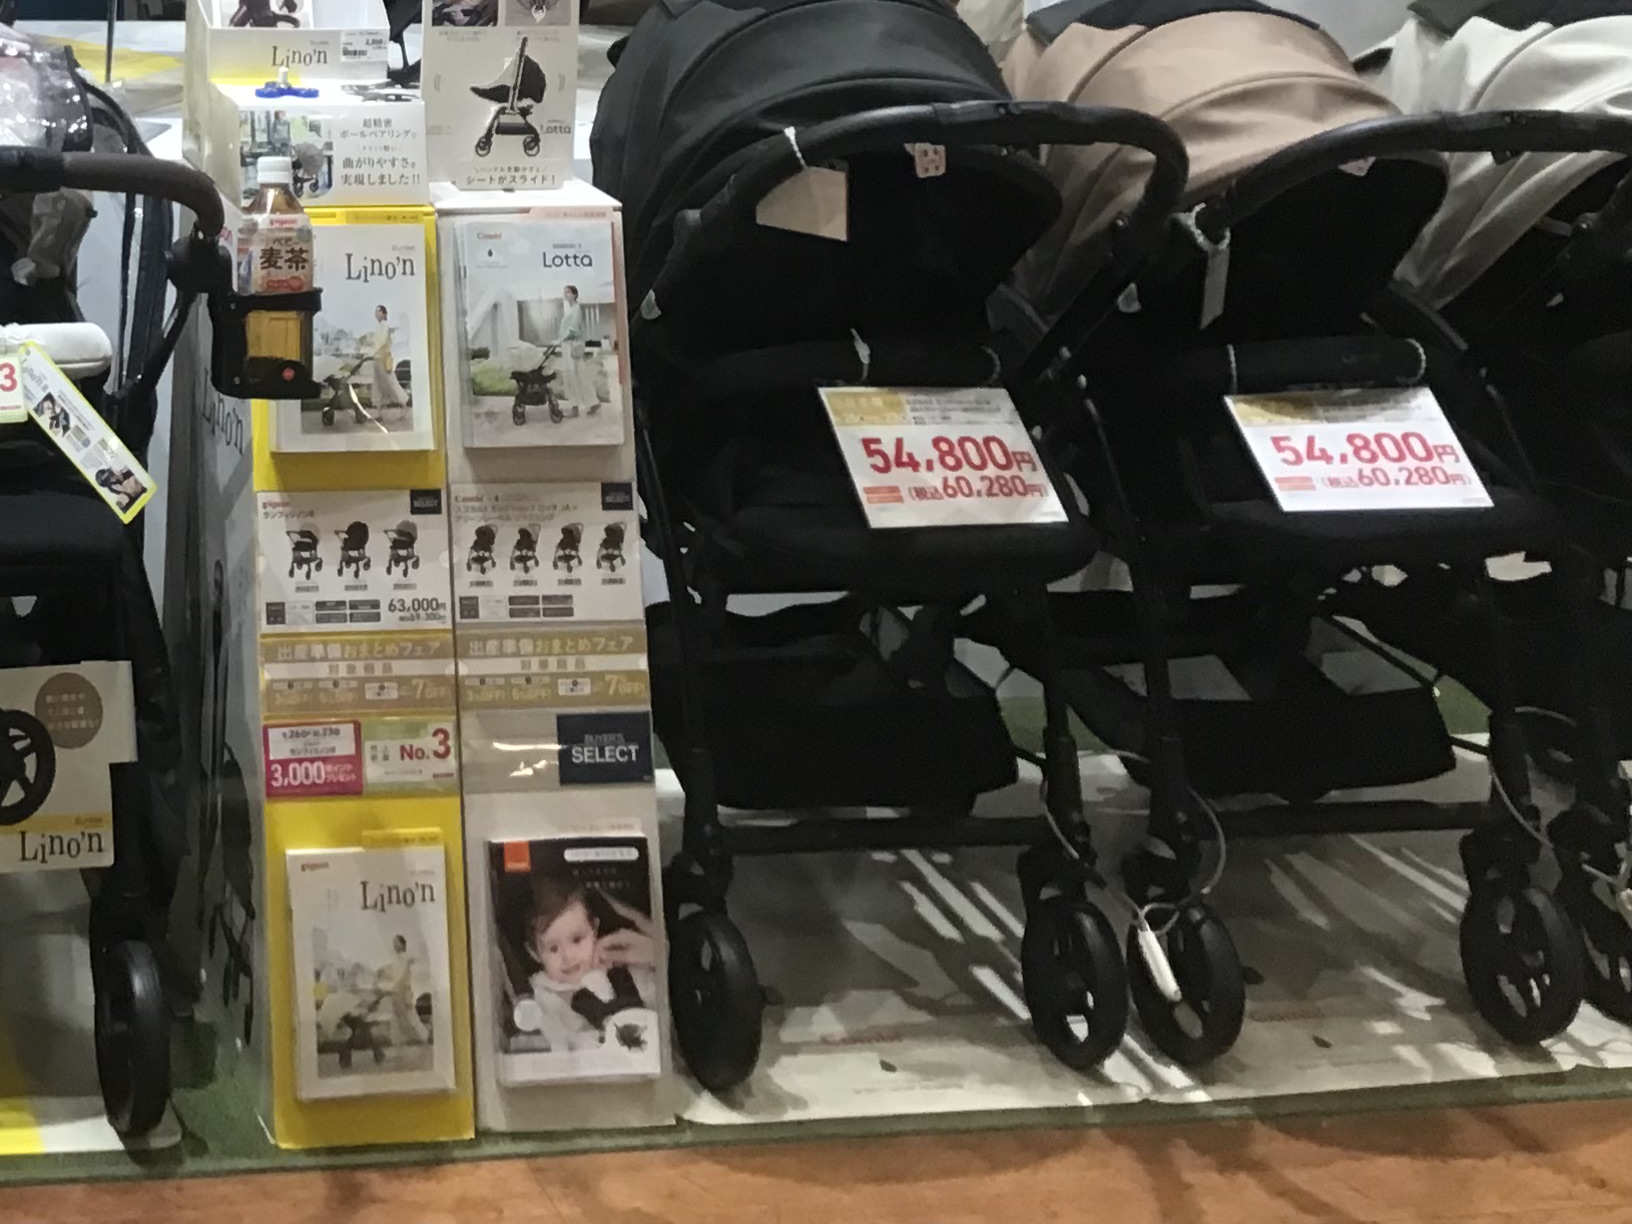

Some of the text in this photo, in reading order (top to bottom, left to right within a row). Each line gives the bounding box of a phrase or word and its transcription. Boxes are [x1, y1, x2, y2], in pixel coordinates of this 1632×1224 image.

[271, 45, 329, 69] Lino'n
[342, 156, 417, 170] 曲がりやすさを
[466, 175, 556, 186] シートがスライド!
[272, 237, 300, 246] ベビー
[259, 246, 310, 272] 麦茶
[345, 252, 416, 283] Lino'n
[542, 251, 594, 268] Lotta
[277, 641, 441, 660] 出産準備おまとめフェア
[469, 636, 634, 656] 出産準備おまとめフェア
[399, 727, 452, 763] No.3
[570, 744, 640, 764] SELECT
[270, 761, 326, 788] 3,000
[18, 829, 105, 866] Lino'n
[360, 880, 436, 914] Lino'n
